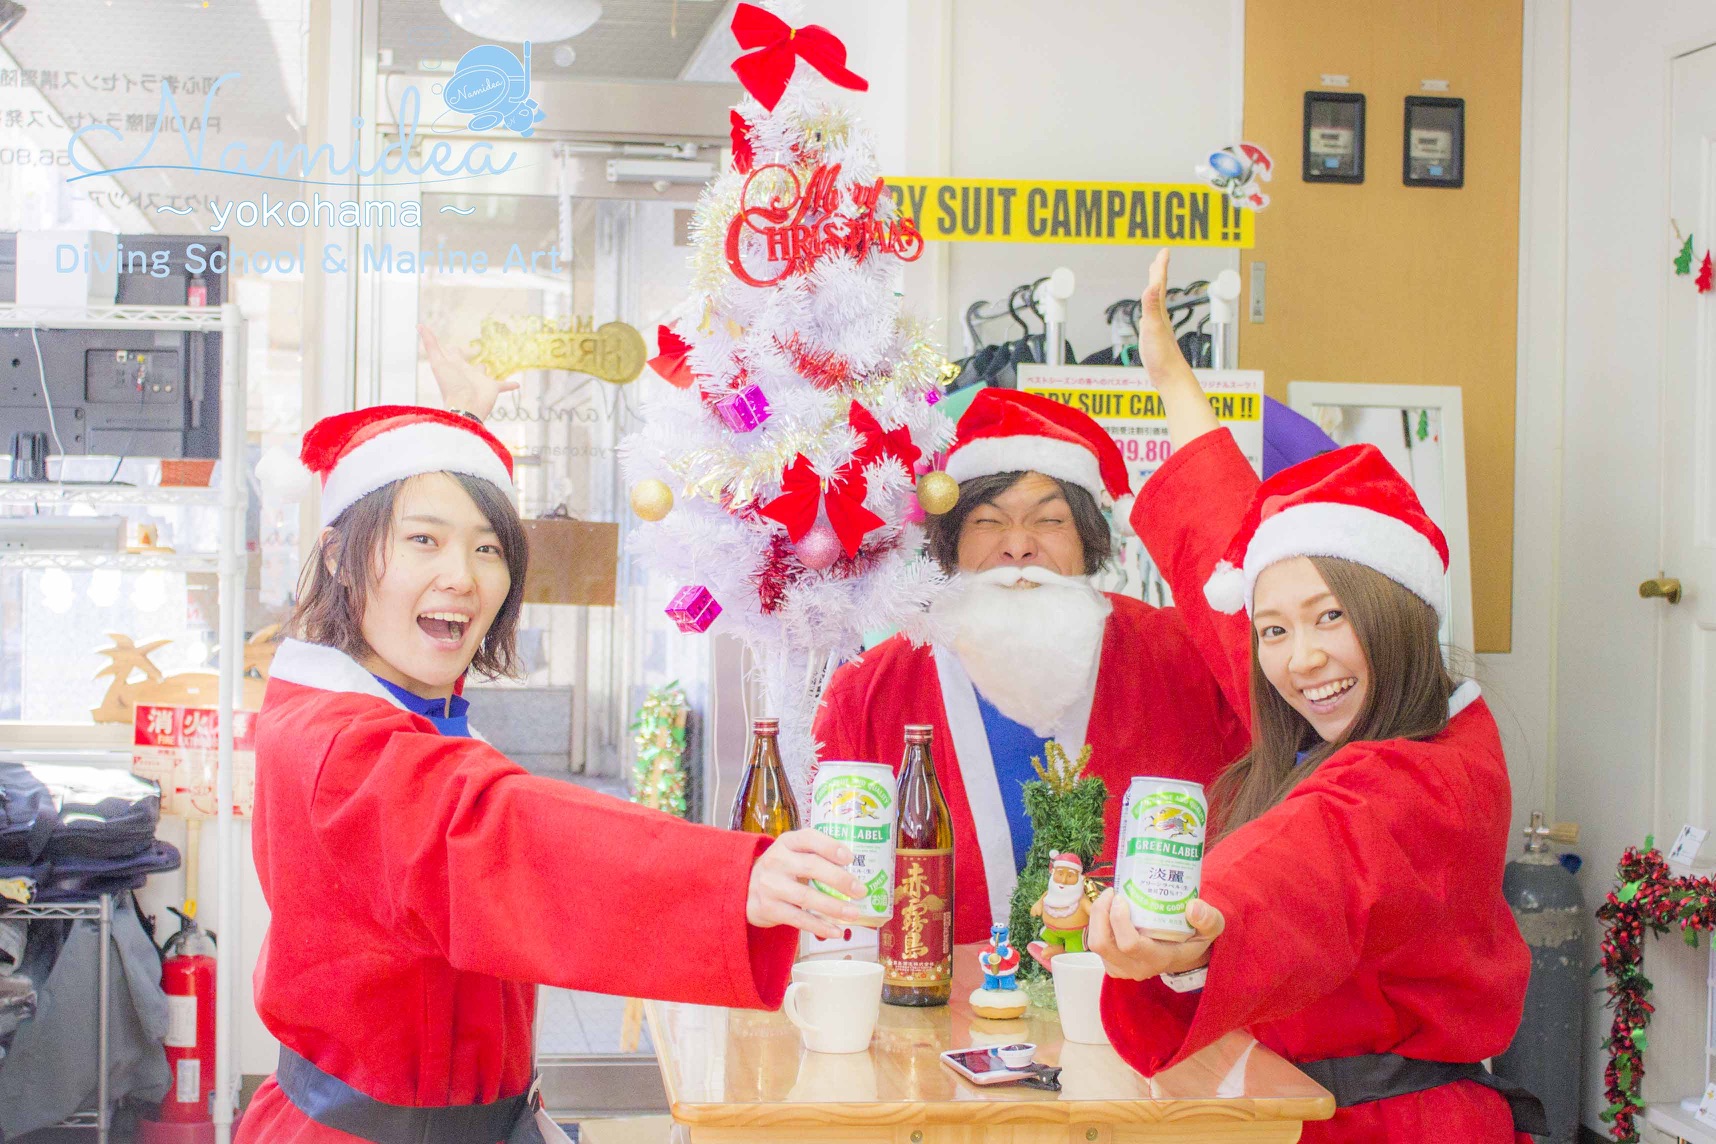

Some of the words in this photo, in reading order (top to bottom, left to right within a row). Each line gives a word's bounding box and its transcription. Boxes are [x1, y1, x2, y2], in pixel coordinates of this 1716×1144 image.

[741, 163, 885, 269] Mery
[937, 184, 1017, 236] SUIT
[1026, 187, 1210, 241] CAMPAIGN
[1078, 392, 1124, 416] SUIT
[851, 829, 883, 841] LABEL
[1135, 839, 1171, 854] GREEN
[1171, 844, 1200, 858] LABEL
[1149, 866, 1185, 884] 淡麗
[901, 862, 930, 961] 赤霧島
